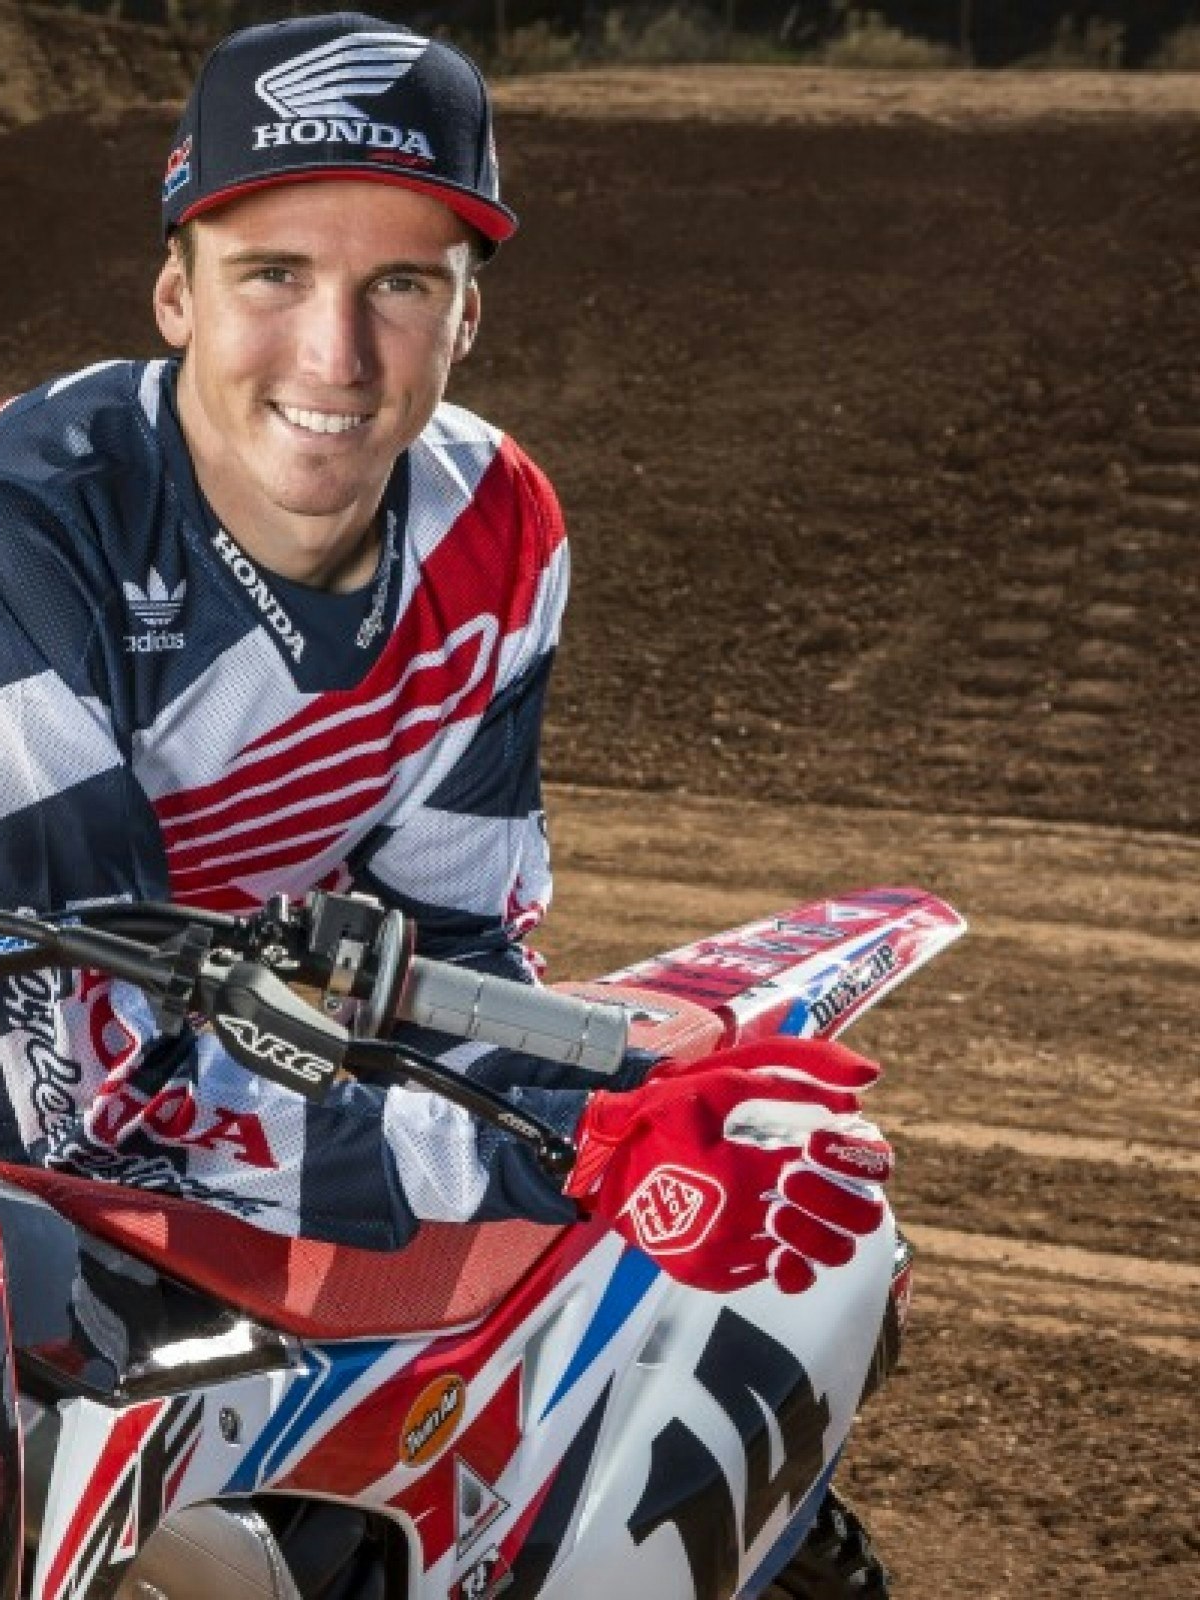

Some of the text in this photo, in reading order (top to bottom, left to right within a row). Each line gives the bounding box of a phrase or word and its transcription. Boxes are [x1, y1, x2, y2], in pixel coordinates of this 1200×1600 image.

[251, 118, 436, 162] HONDA
[211, 527, 307, 665] HONDA
[626, 1304, 831, 1600] 14
